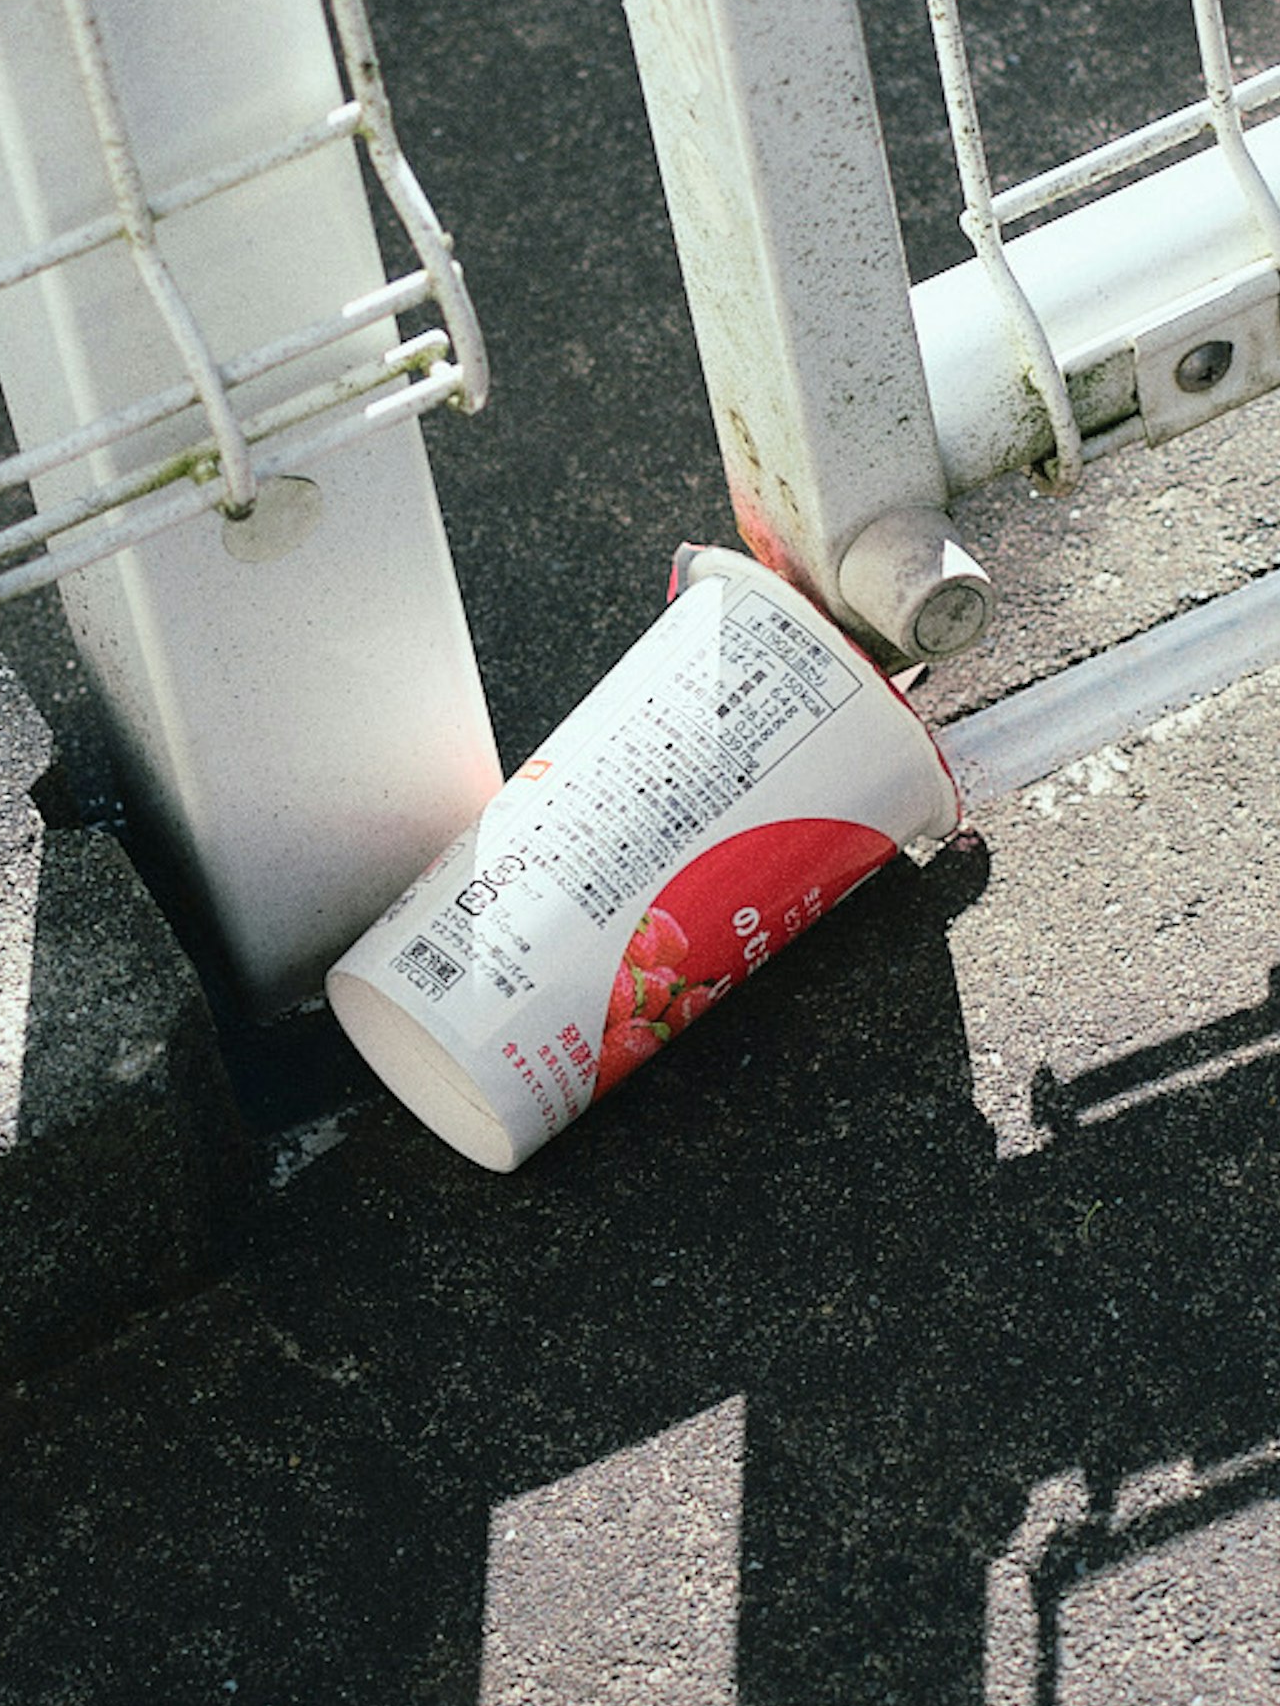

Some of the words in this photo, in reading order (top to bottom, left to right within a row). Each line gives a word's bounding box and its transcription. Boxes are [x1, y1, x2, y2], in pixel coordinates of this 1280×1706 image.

[769, 685, 799, 719] 6.4g
[778, 671, 826, 719] 150kcal
[738, 702, 774, 742] 28.3g
[717, 727, 760, 775] 239mg
[553, 1021, 603, 1086] 発酵乳
